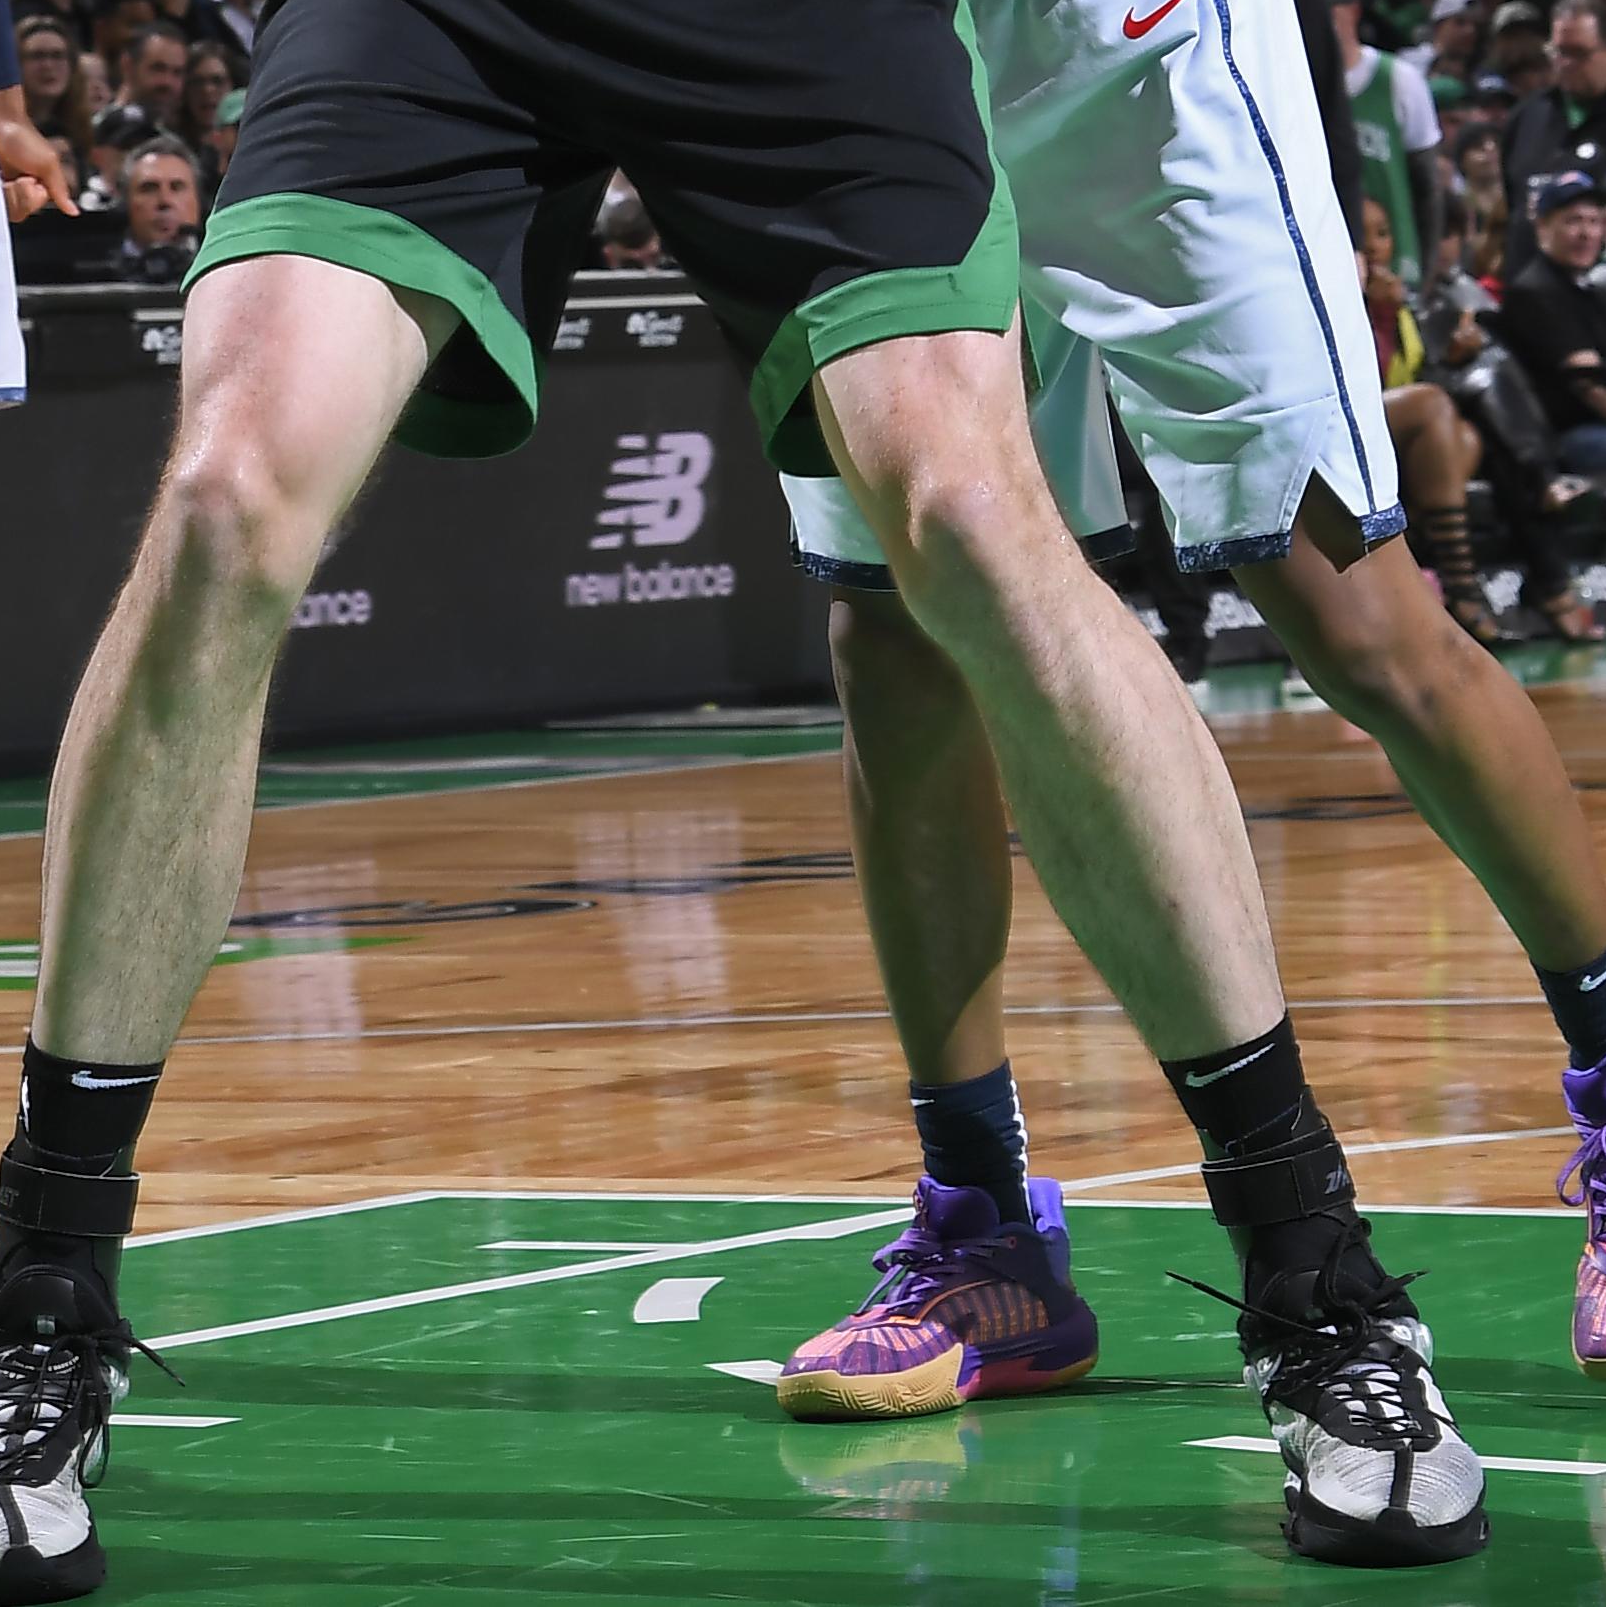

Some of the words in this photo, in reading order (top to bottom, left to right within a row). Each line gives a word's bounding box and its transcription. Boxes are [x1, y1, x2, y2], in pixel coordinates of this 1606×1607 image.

[565, 573, 622, 607] new
[624, 562, 736, 604] balance
[289, 590, 372, 629] ance
